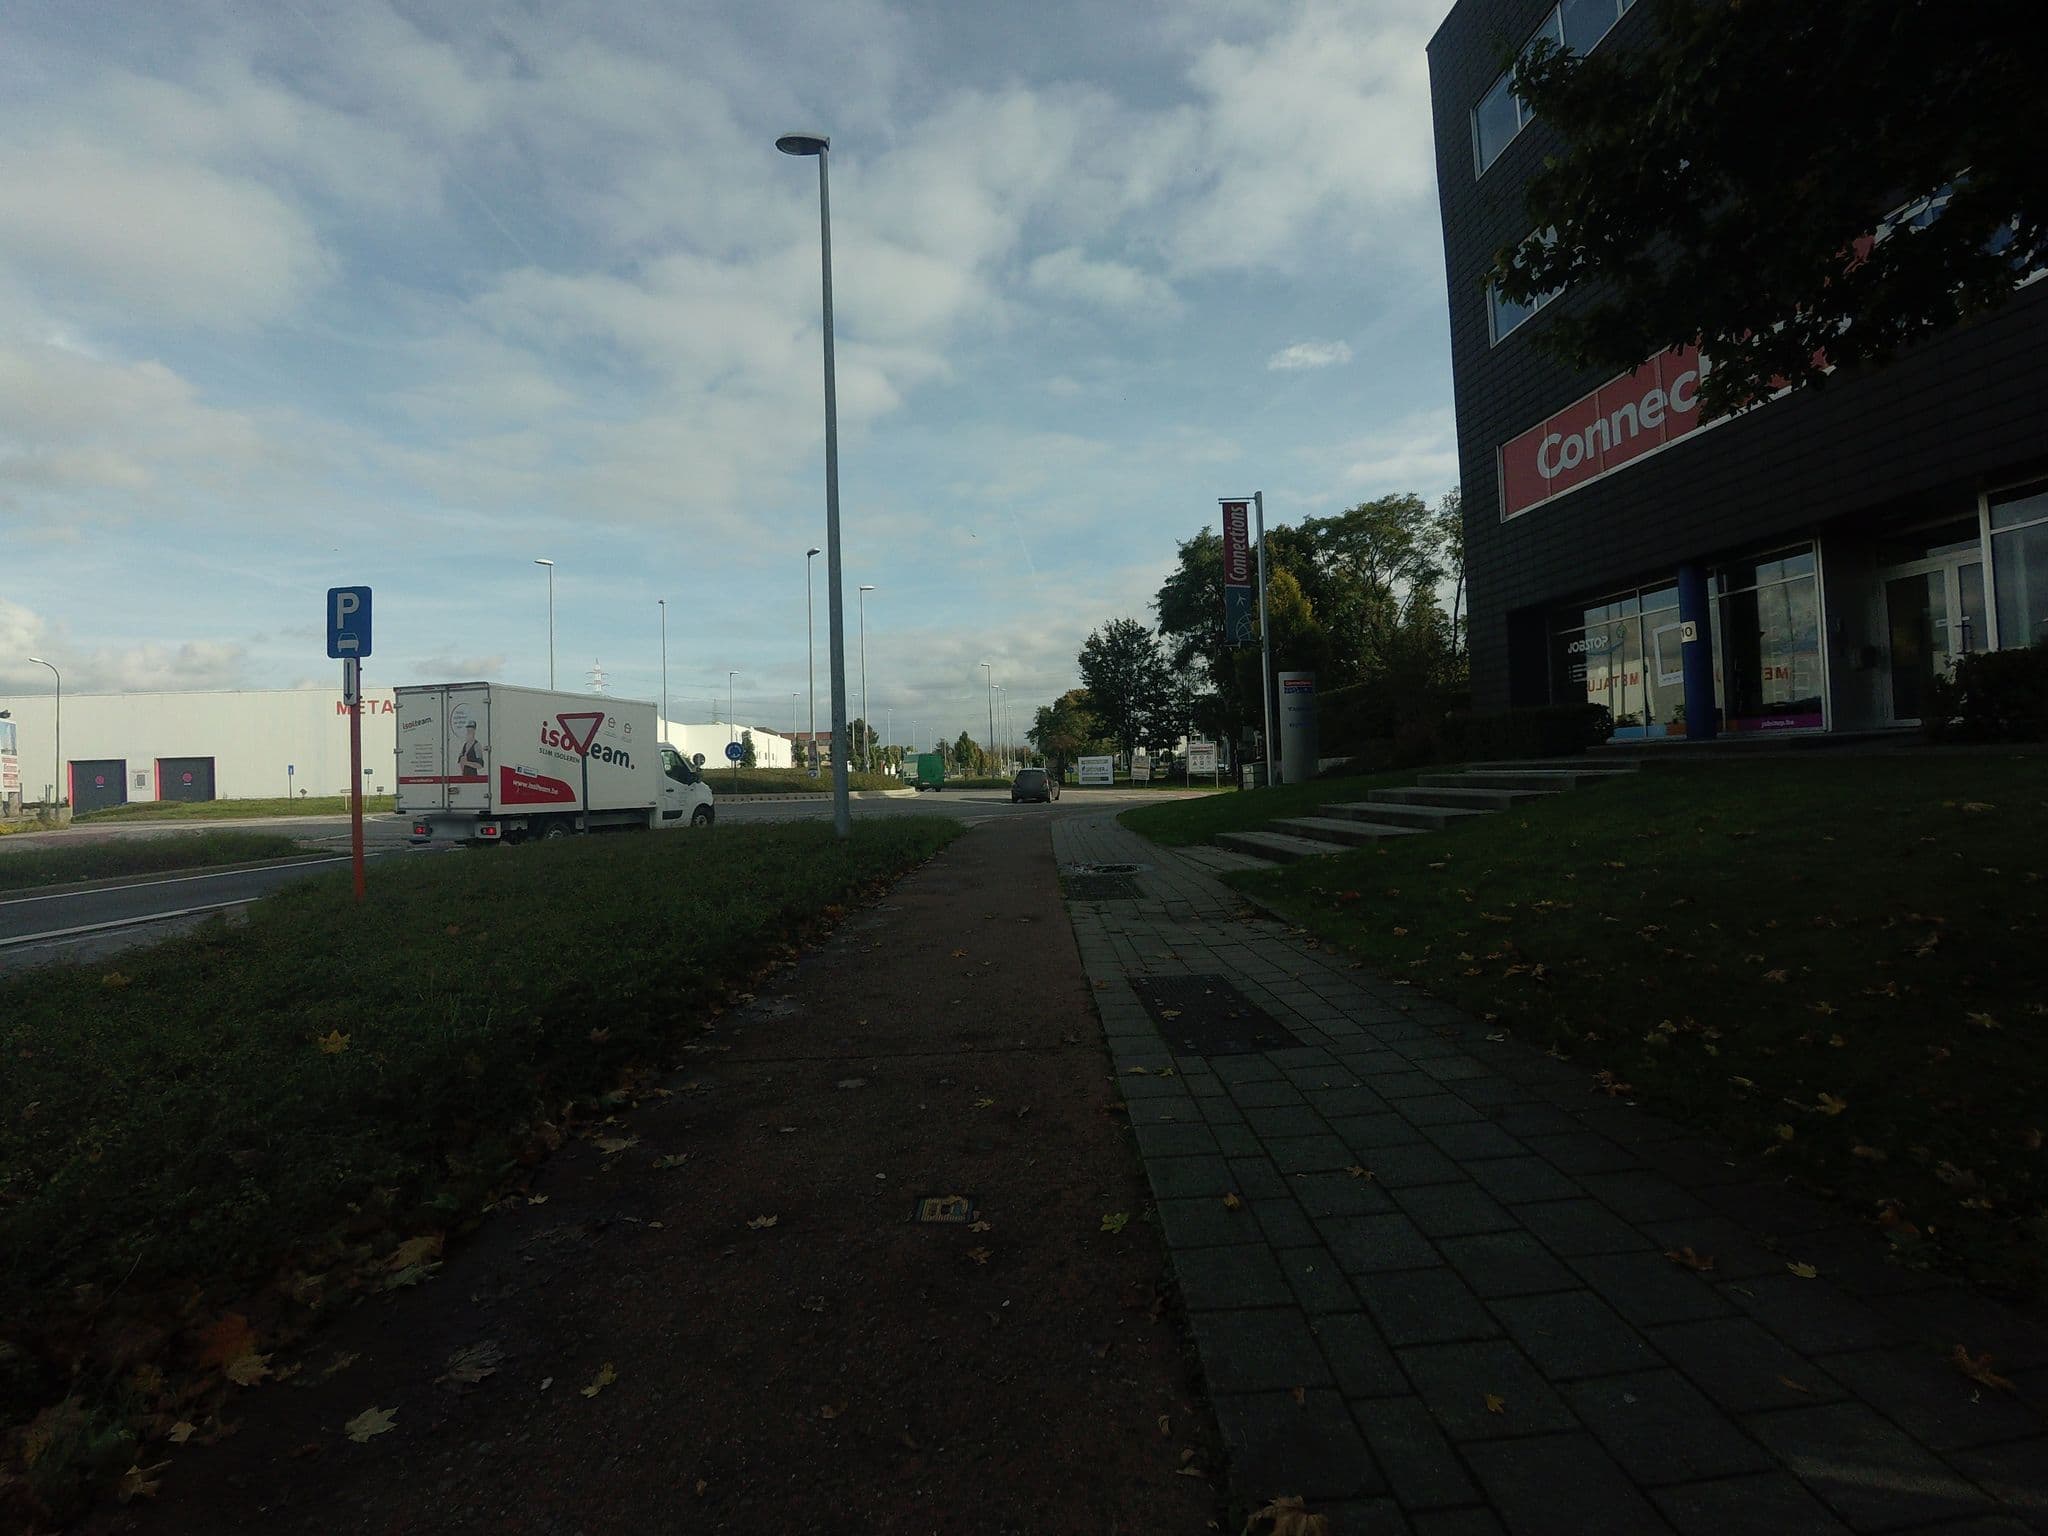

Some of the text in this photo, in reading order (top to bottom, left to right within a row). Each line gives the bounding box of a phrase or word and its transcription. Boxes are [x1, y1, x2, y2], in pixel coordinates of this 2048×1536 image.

[1228, 505, 1248, 582] Connections
[336, 592, 360, 630] P
[1681, 626, 1693, 638] 10
